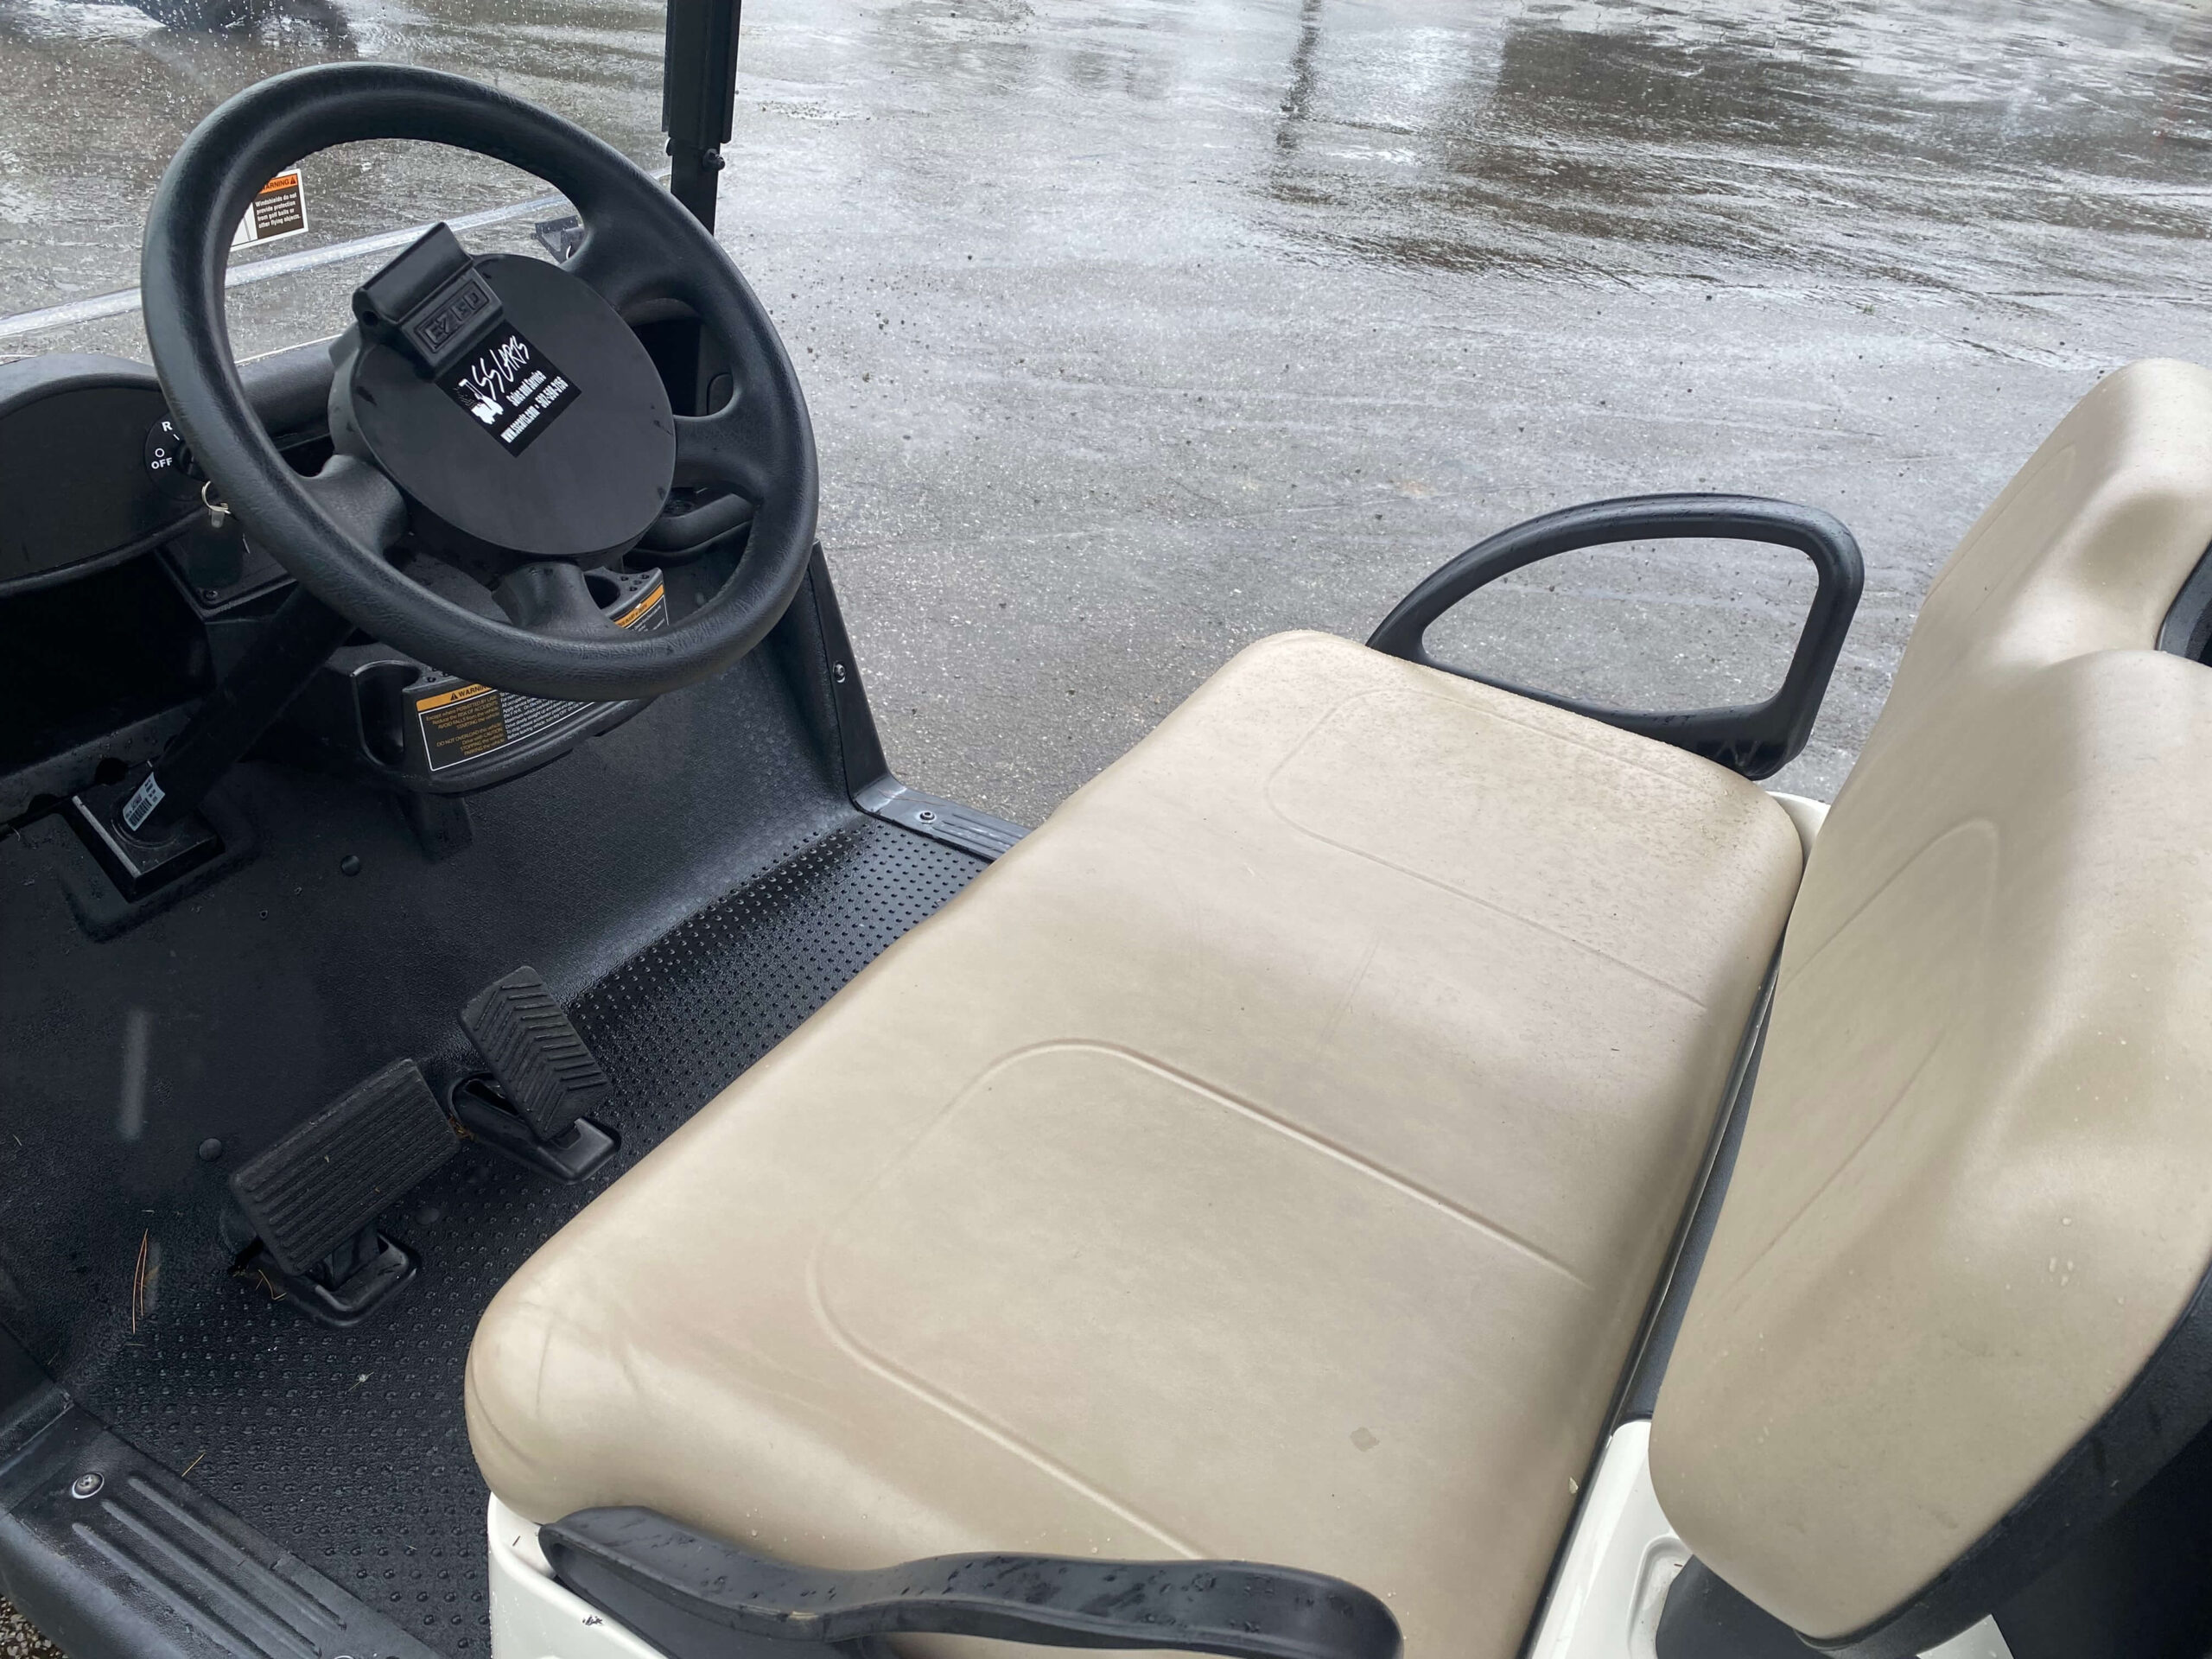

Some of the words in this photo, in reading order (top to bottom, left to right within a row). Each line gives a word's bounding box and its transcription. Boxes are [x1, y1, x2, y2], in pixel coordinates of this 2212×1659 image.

[523, 370, 547, 390] Service
[518, 381, 534, 397] and
[505, 390, 526, 407] Sales
[161, 421, 173, 432] R
[151, 457, 173, 469] OFF
[458, 685, 486, 697] WARNIN
